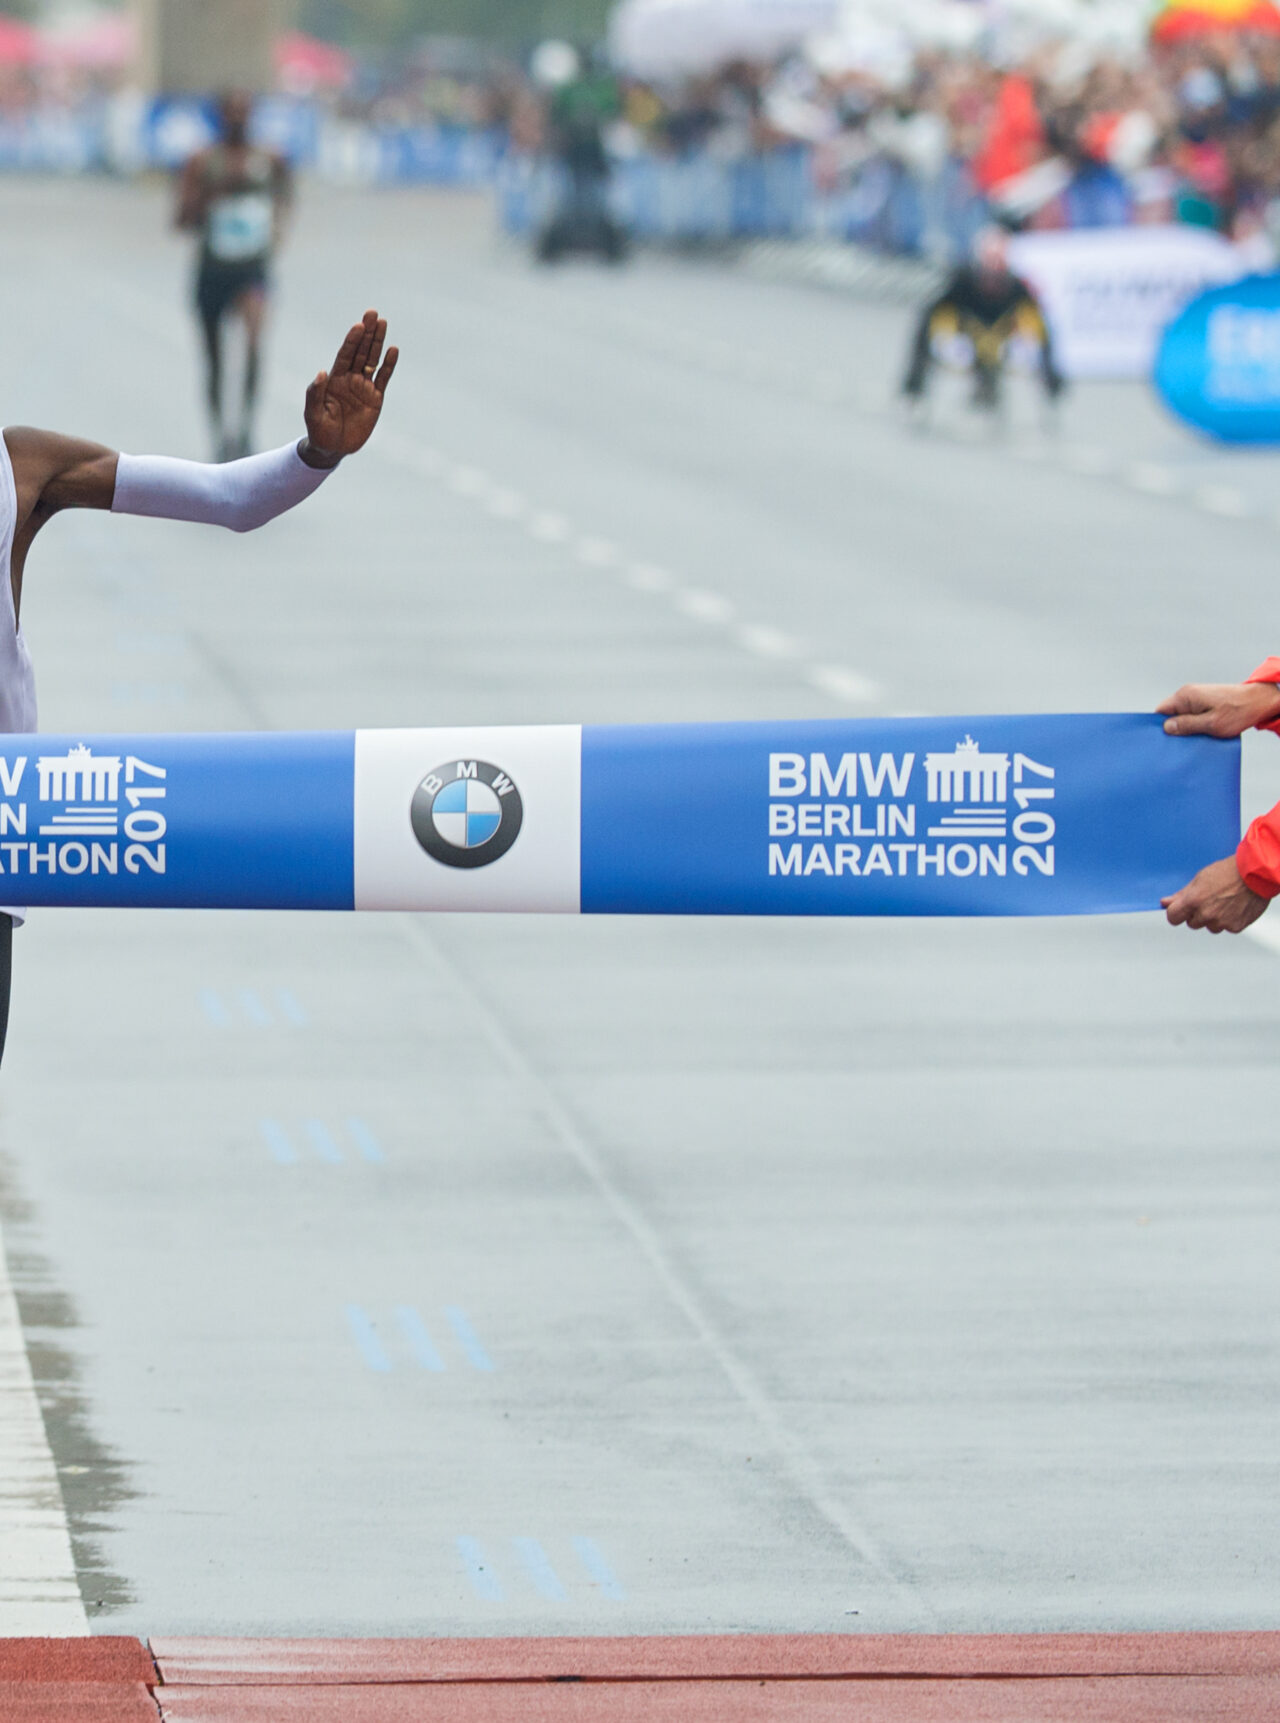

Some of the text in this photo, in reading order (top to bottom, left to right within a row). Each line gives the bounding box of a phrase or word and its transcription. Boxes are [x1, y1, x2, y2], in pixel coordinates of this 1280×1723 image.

[420, 761, 515, 797] BMW
[768, 752, 916, 797] BMW
[124, 755, 167, 874] 2017
[768, 804, 916, 837] BERLIN
[1012, 752, 1056, 876] 2017
[768, 843, 1007, 877] MARATHON
